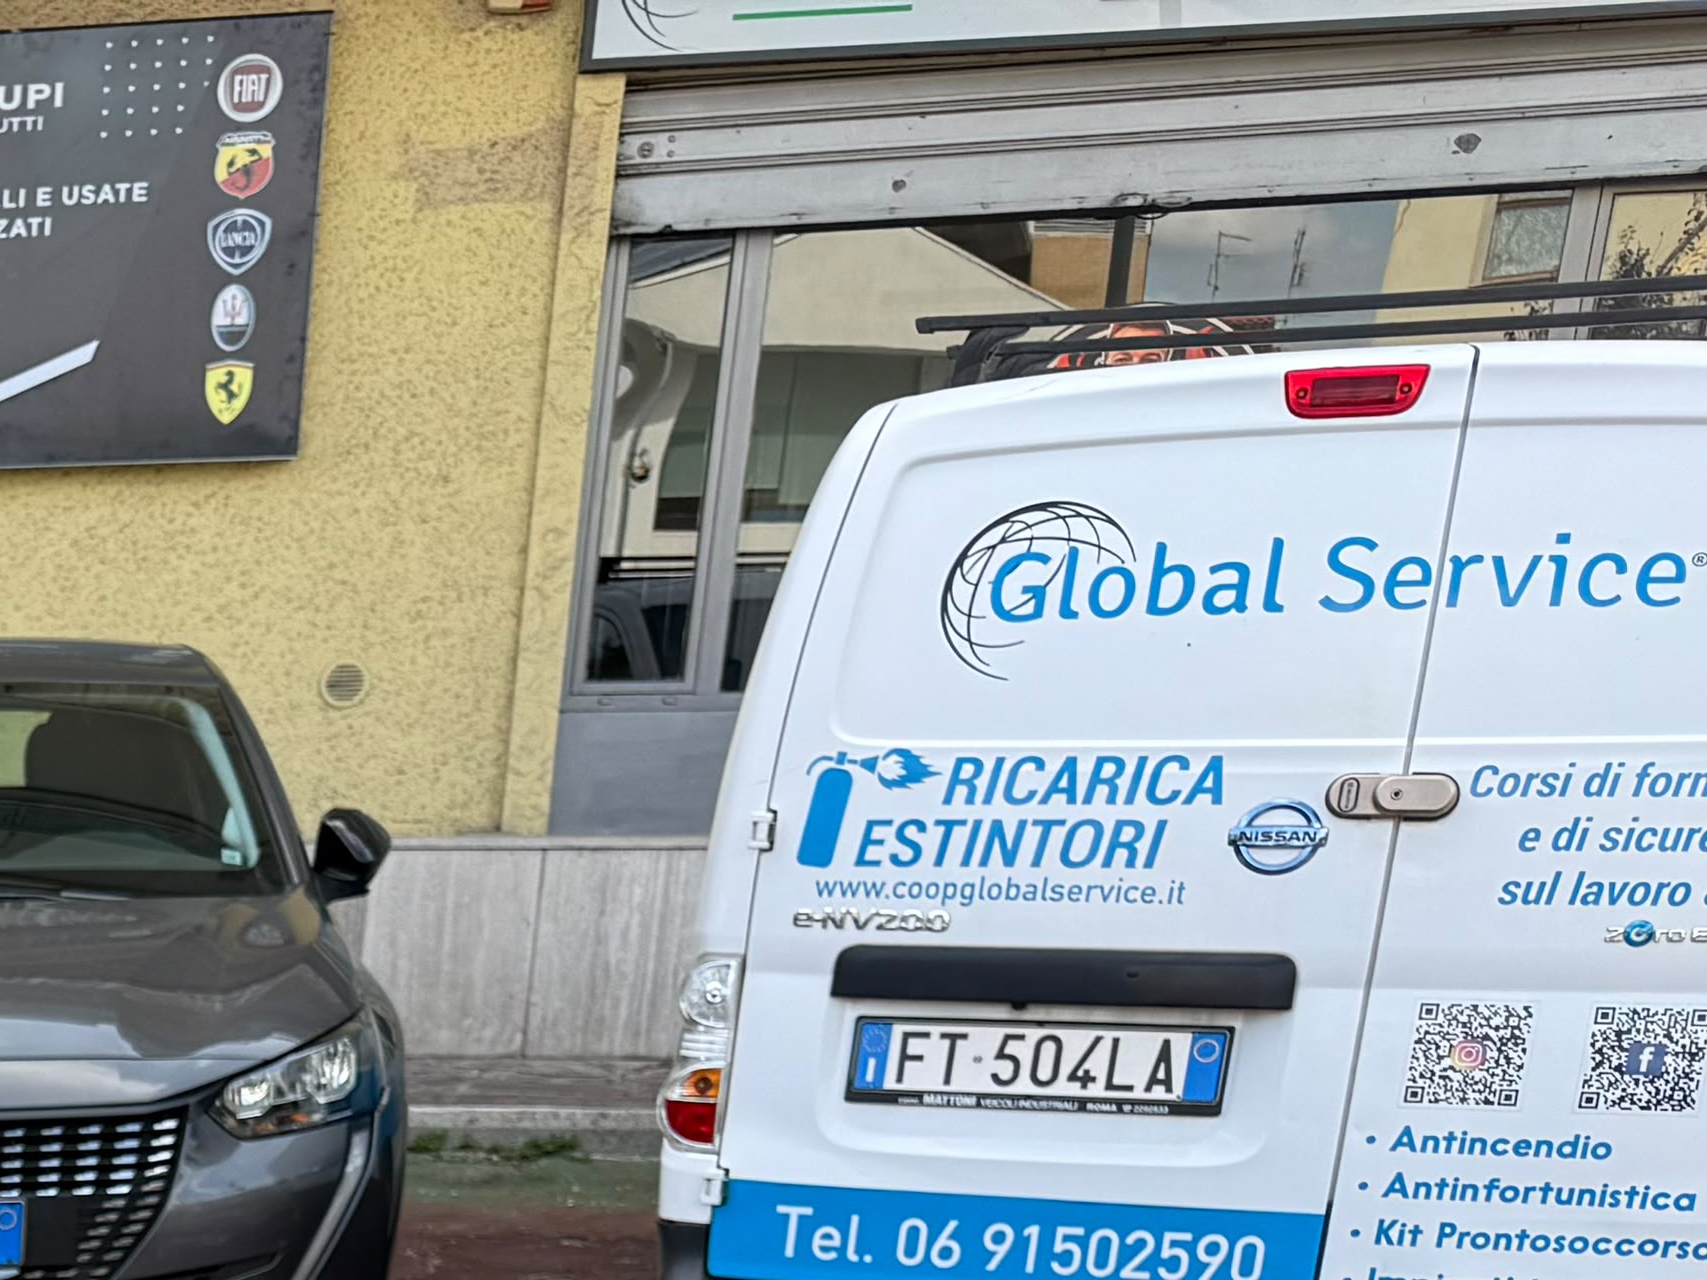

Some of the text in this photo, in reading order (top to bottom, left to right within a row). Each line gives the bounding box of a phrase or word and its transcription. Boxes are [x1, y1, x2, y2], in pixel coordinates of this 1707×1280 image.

[233, 73, 269, 103] FIAT
[36, 187, 53, 207] E
[62, 182, 149, 206] USATE
[989, 533, 1687, 624] Global Service
[943, 755, 1223, 806] RICARICA
[1470, 762, 1576, 798] Corsi
[1583, 762, 1625, 798] di
[854, 819, 1168, 869] ESTINTORI
[1238, 830, 1317, 843] NISSAN
[1518, 827, 1541, 852] e
[1551, 816, 1593, 852] di
[815, 875, 1186, 907] www.coopglobalservice.it
[1497, 871, 1562, 906] sul
[1568, 871, 1692, 907] lavoro
[1086, 1101, 1117, 1113] ROMA
[1388, 1125, 1612, 1160] Antincendio
[1381, 1171, 1697, 1212] Antinfortunistica
[776, 1205, 873, 1263] Tel.
[895, 1217, 962, 1269] 06
[1374, 1218, 1424, 1248] Kit
